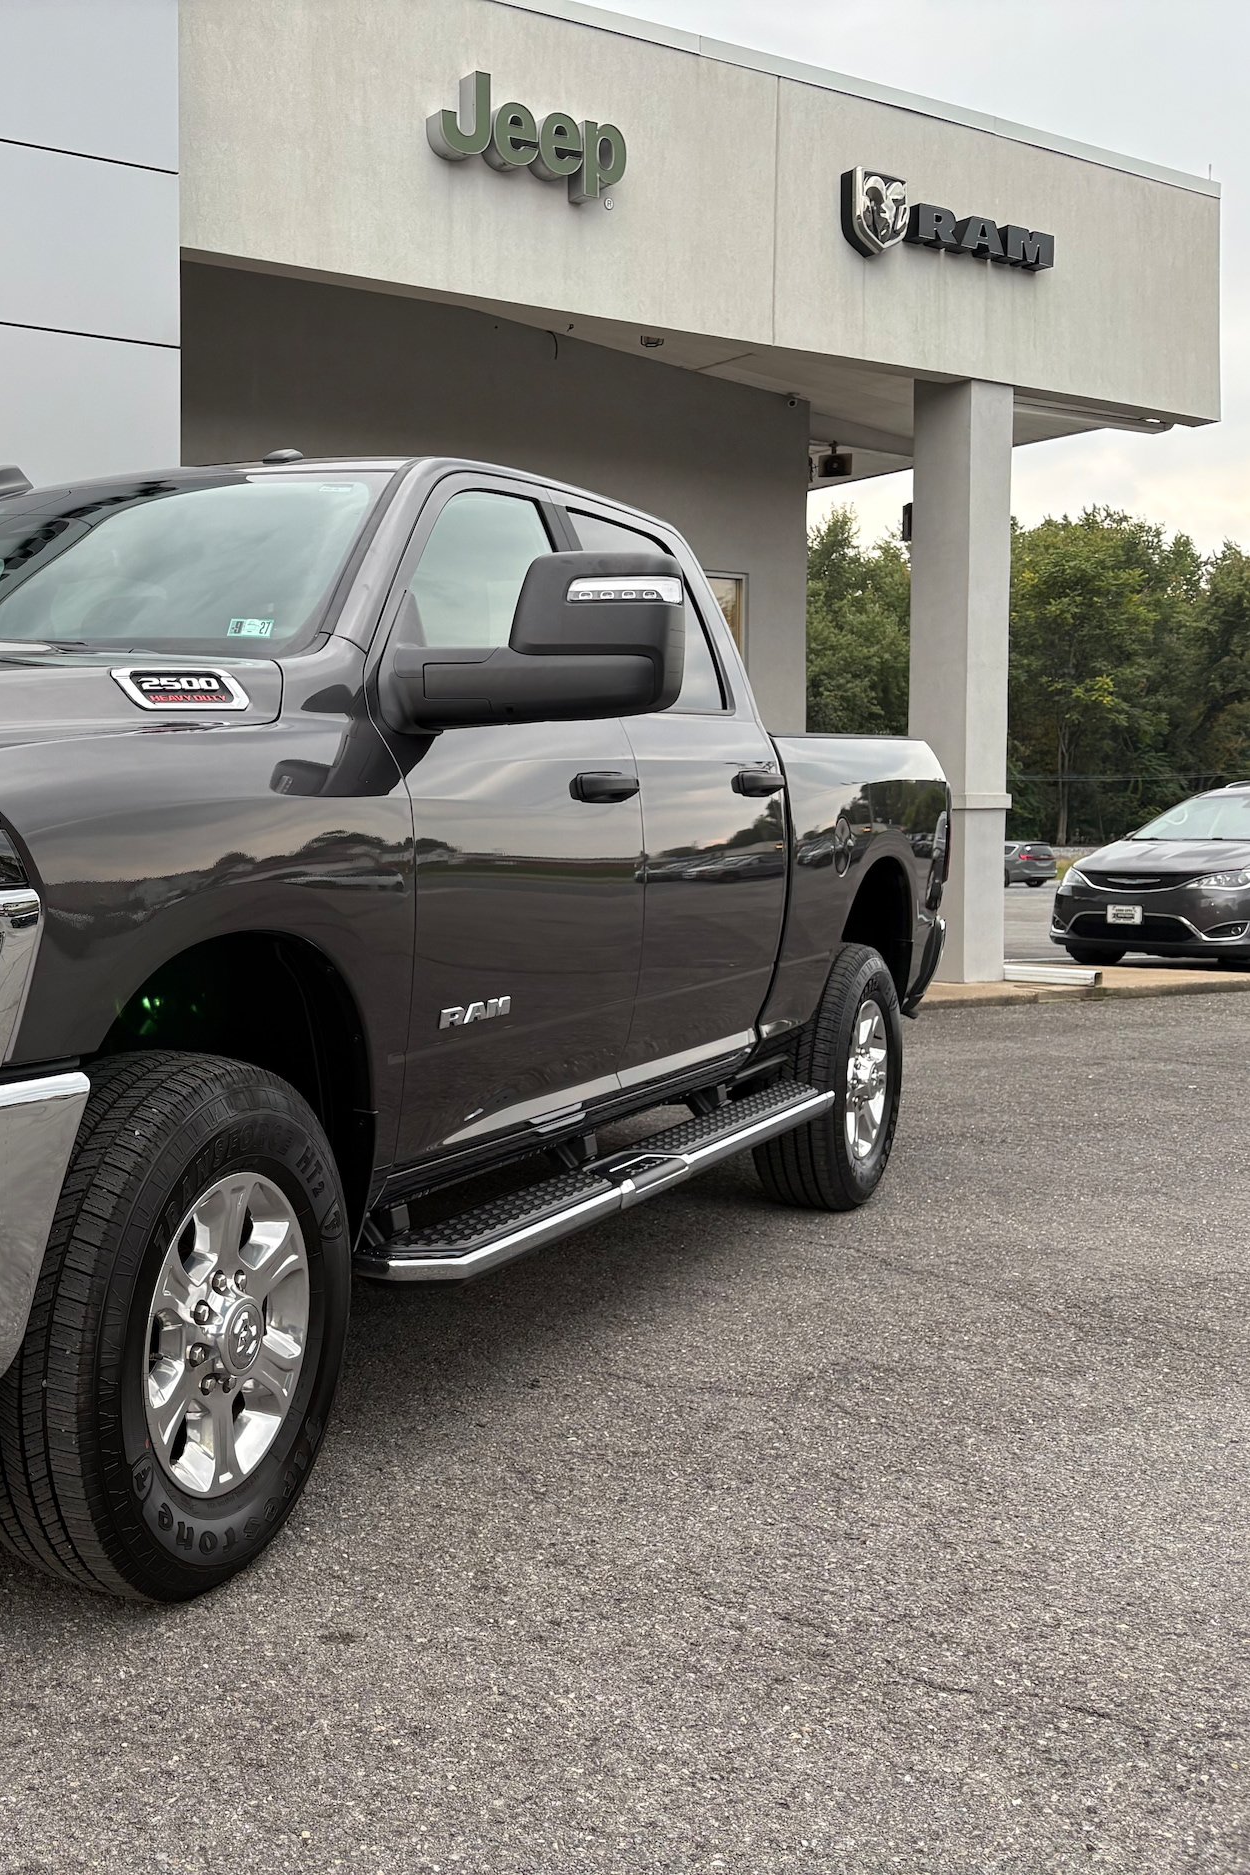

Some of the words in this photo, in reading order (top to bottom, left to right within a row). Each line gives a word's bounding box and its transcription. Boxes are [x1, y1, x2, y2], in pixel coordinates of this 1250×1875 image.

[427, 71, 627, 202] Jeep
[905, 203, 1054, 271] RAM
[259, 621, 271, 635] 27
[138, 677, 220, 690] 2500
[149, 694, 192, 703] HEAVY
[193, 694, 227, 703] DUTY
[438, 995, 512, 1030] RAM
